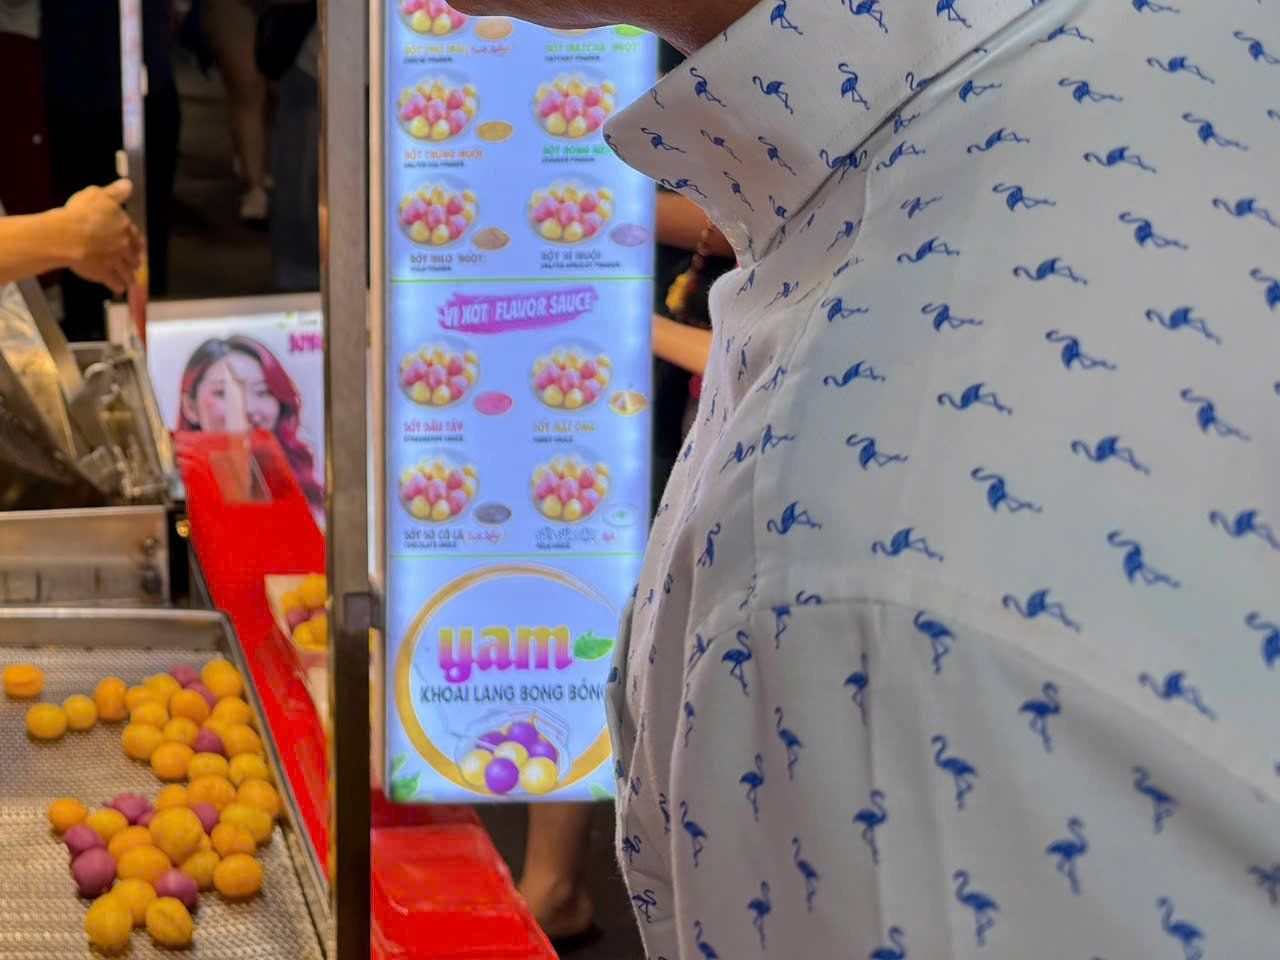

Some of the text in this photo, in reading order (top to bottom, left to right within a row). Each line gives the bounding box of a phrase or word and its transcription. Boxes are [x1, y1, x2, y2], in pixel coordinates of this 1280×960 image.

[495, 297, 546, 321] FLAVOR
[549, 292, 593, 315] SAUCE
[438, 625, 573, 683] yam
[420, 686, 469, 703] KHOAI
[473, 685, 515, 702] LANG
[520, 685, 565, 702] BONG
